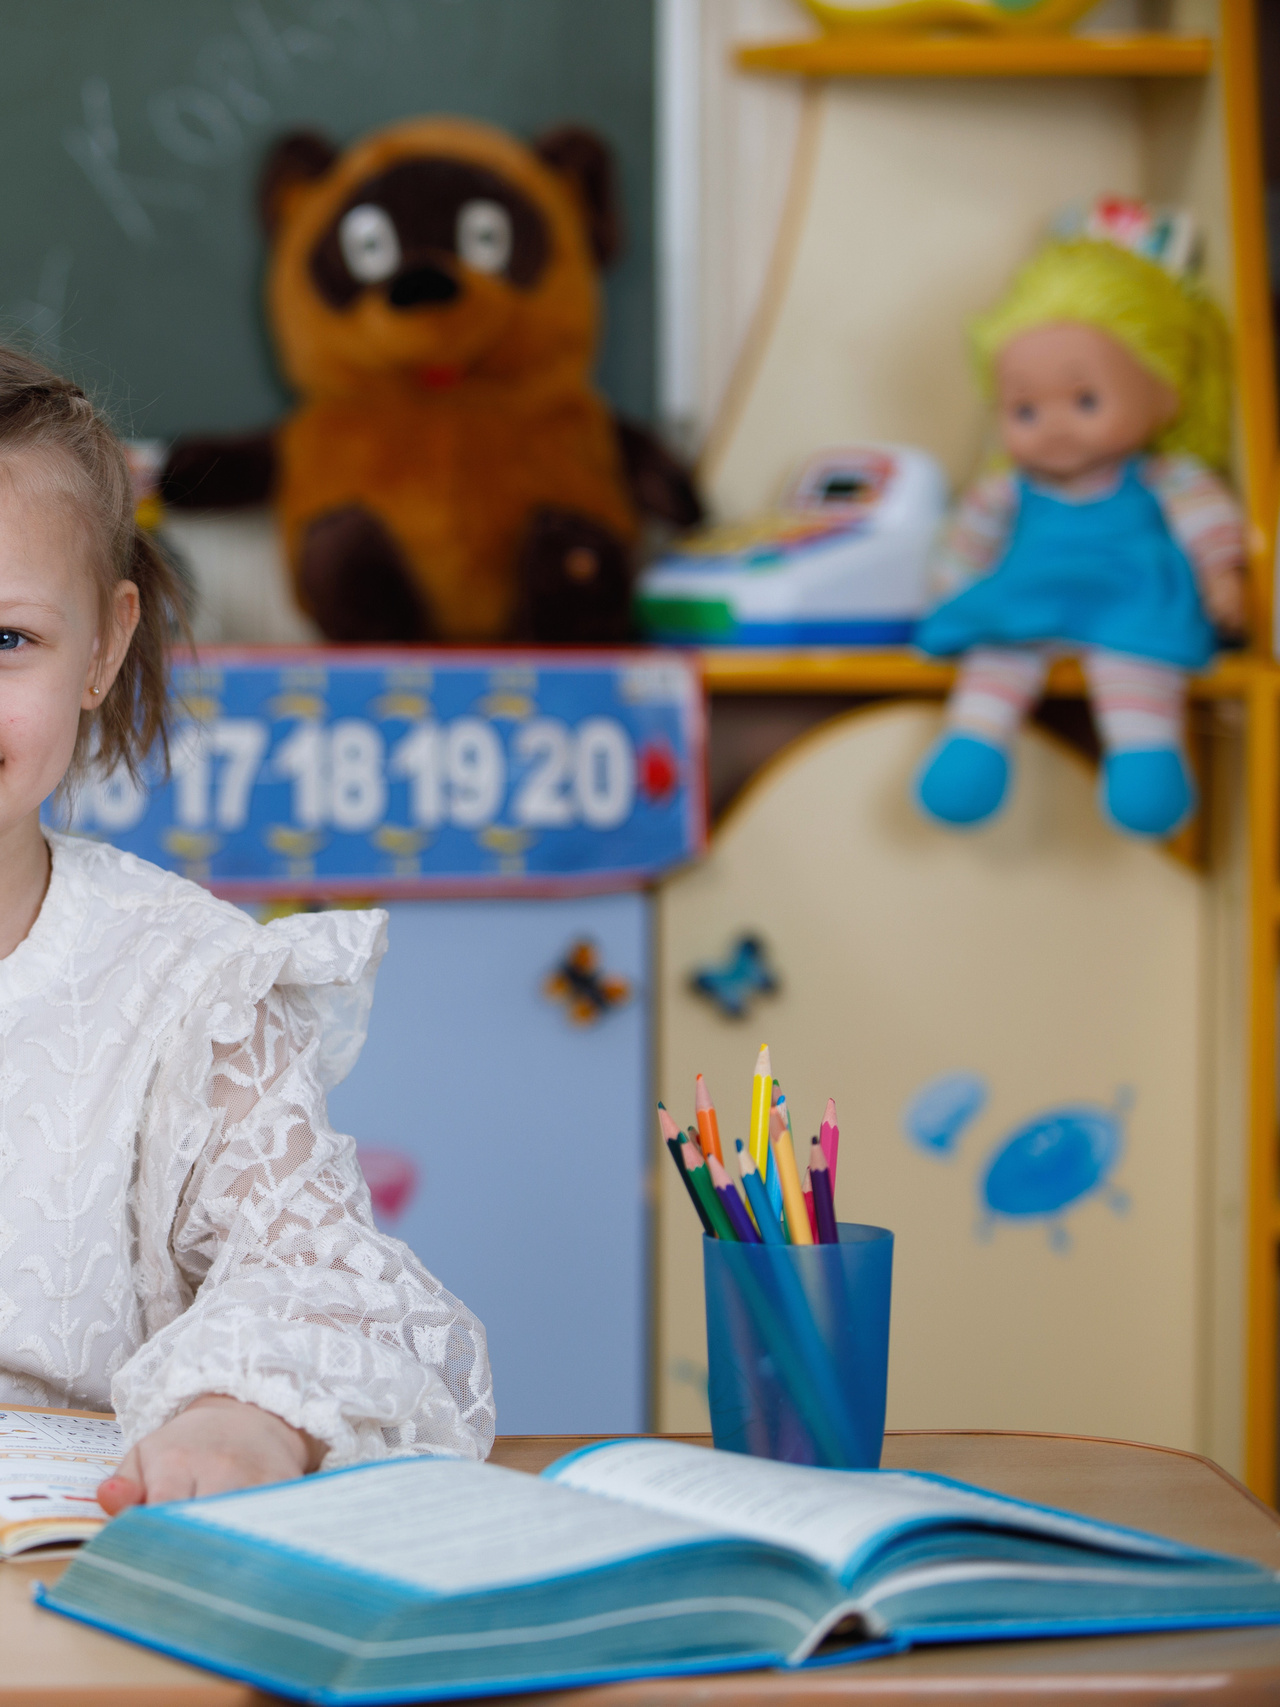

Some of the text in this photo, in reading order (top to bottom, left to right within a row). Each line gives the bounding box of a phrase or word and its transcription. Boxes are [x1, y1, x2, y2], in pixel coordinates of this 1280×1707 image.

[170, 717, 268, 832] 17
[274, 716, 390, 832] 18
[391, 714, 506, 832] 19
[510, 713, 635, 832] 20
